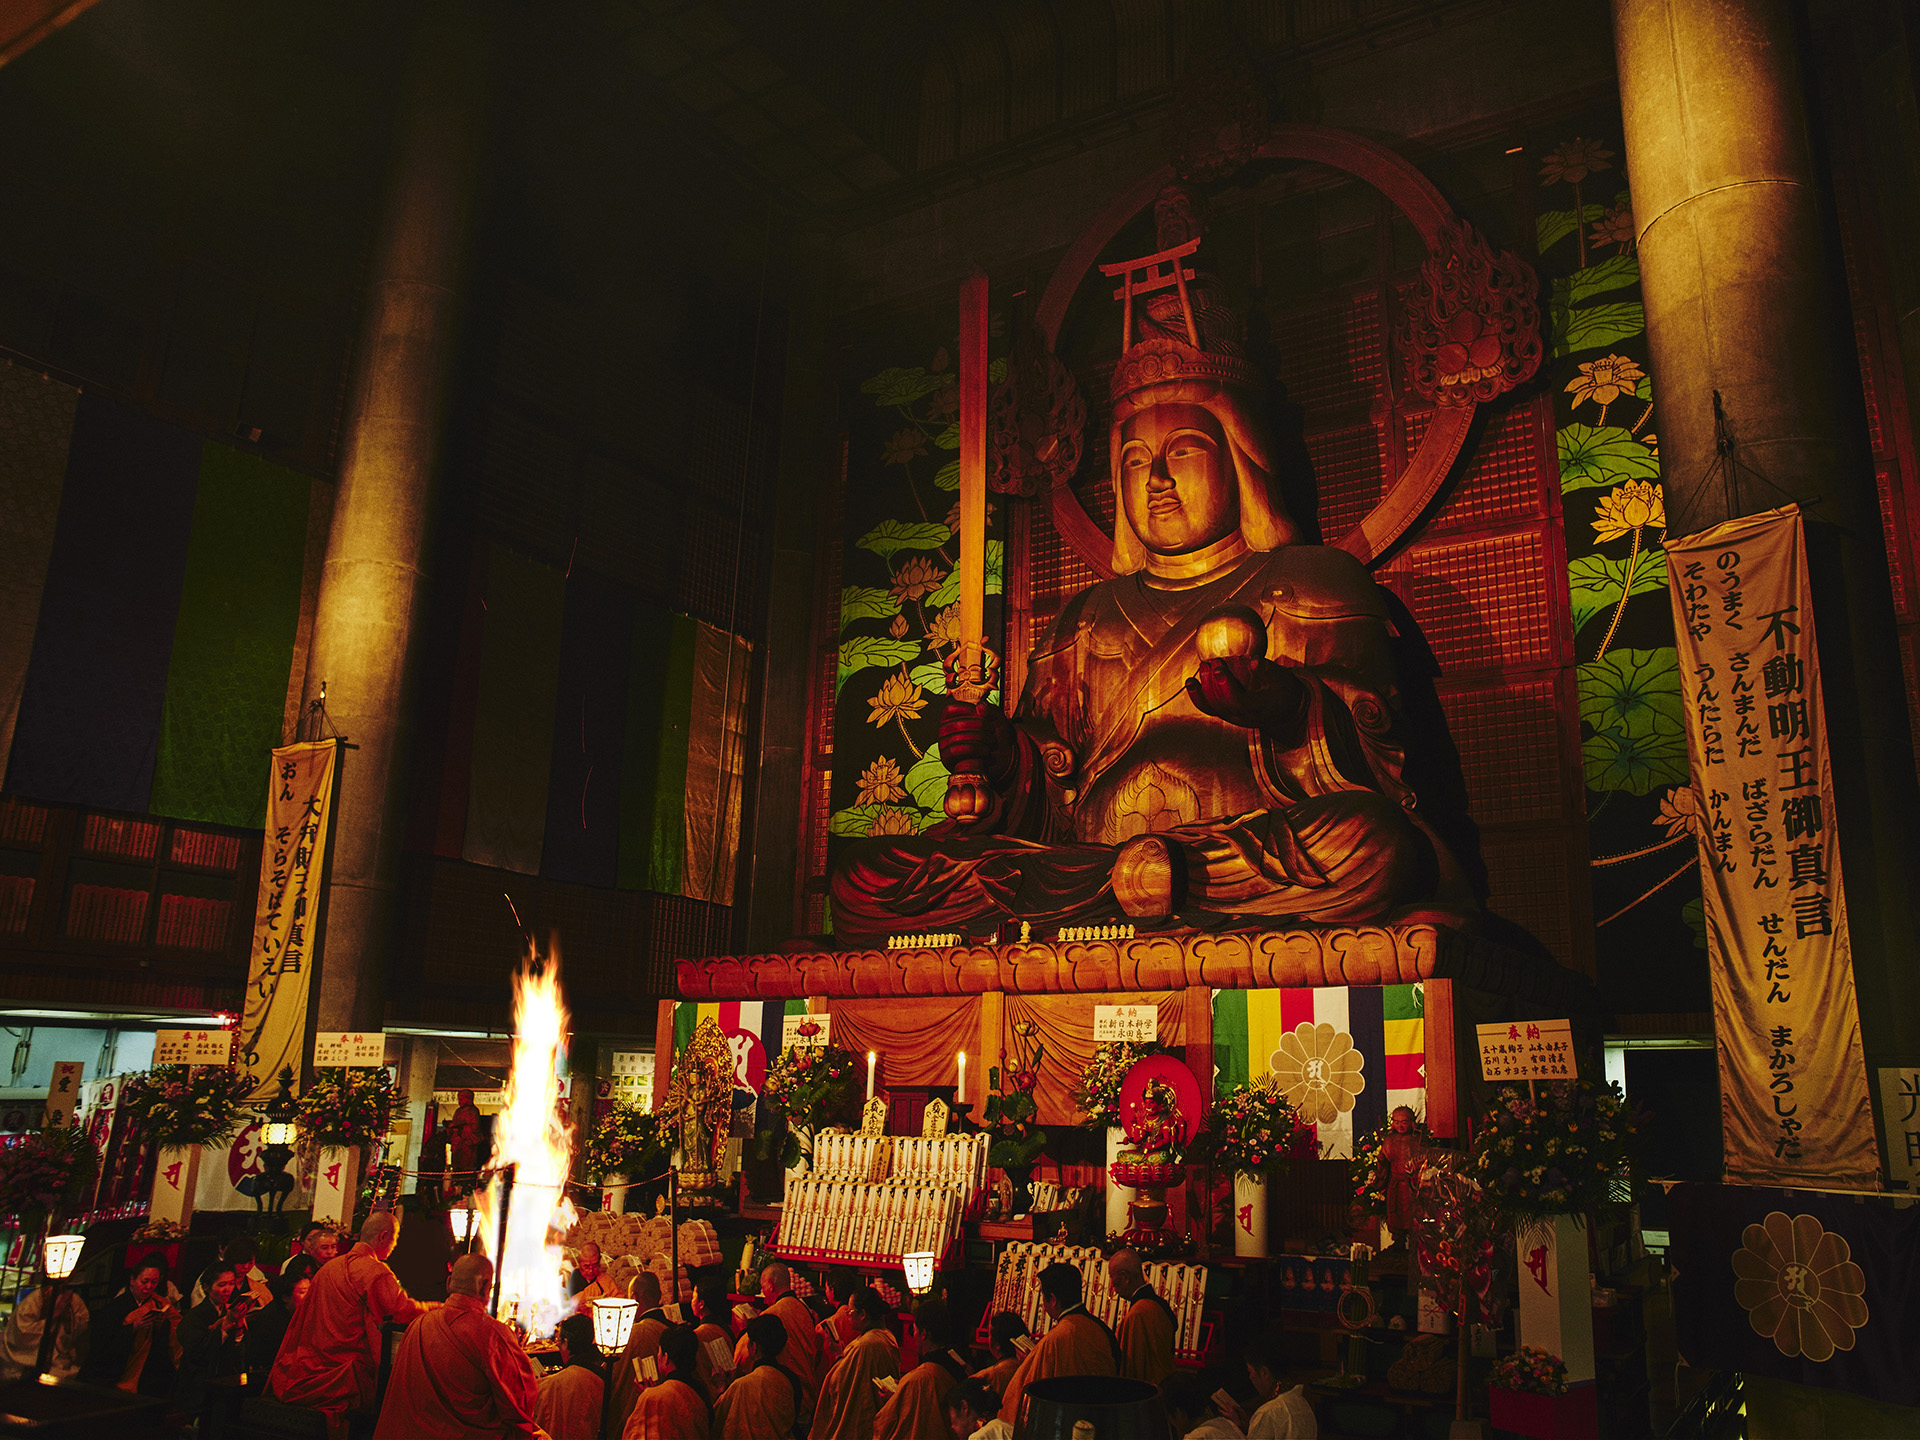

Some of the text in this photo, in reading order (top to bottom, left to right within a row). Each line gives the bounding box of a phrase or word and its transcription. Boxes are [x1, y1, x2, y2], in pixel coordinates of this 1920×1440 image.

[279, 762, 297, 802] おん
[1683, 561, 1737, 873] そわたや うんたらた かんまん
[1716, 551, 1803, 1159] のうまく さんまんだ ばざらだん せんだん まかろしゃだ
[1756, 604, 1833, 940] 不動明王御真言
[1508, 1023, 1540, 1041] 奉納
